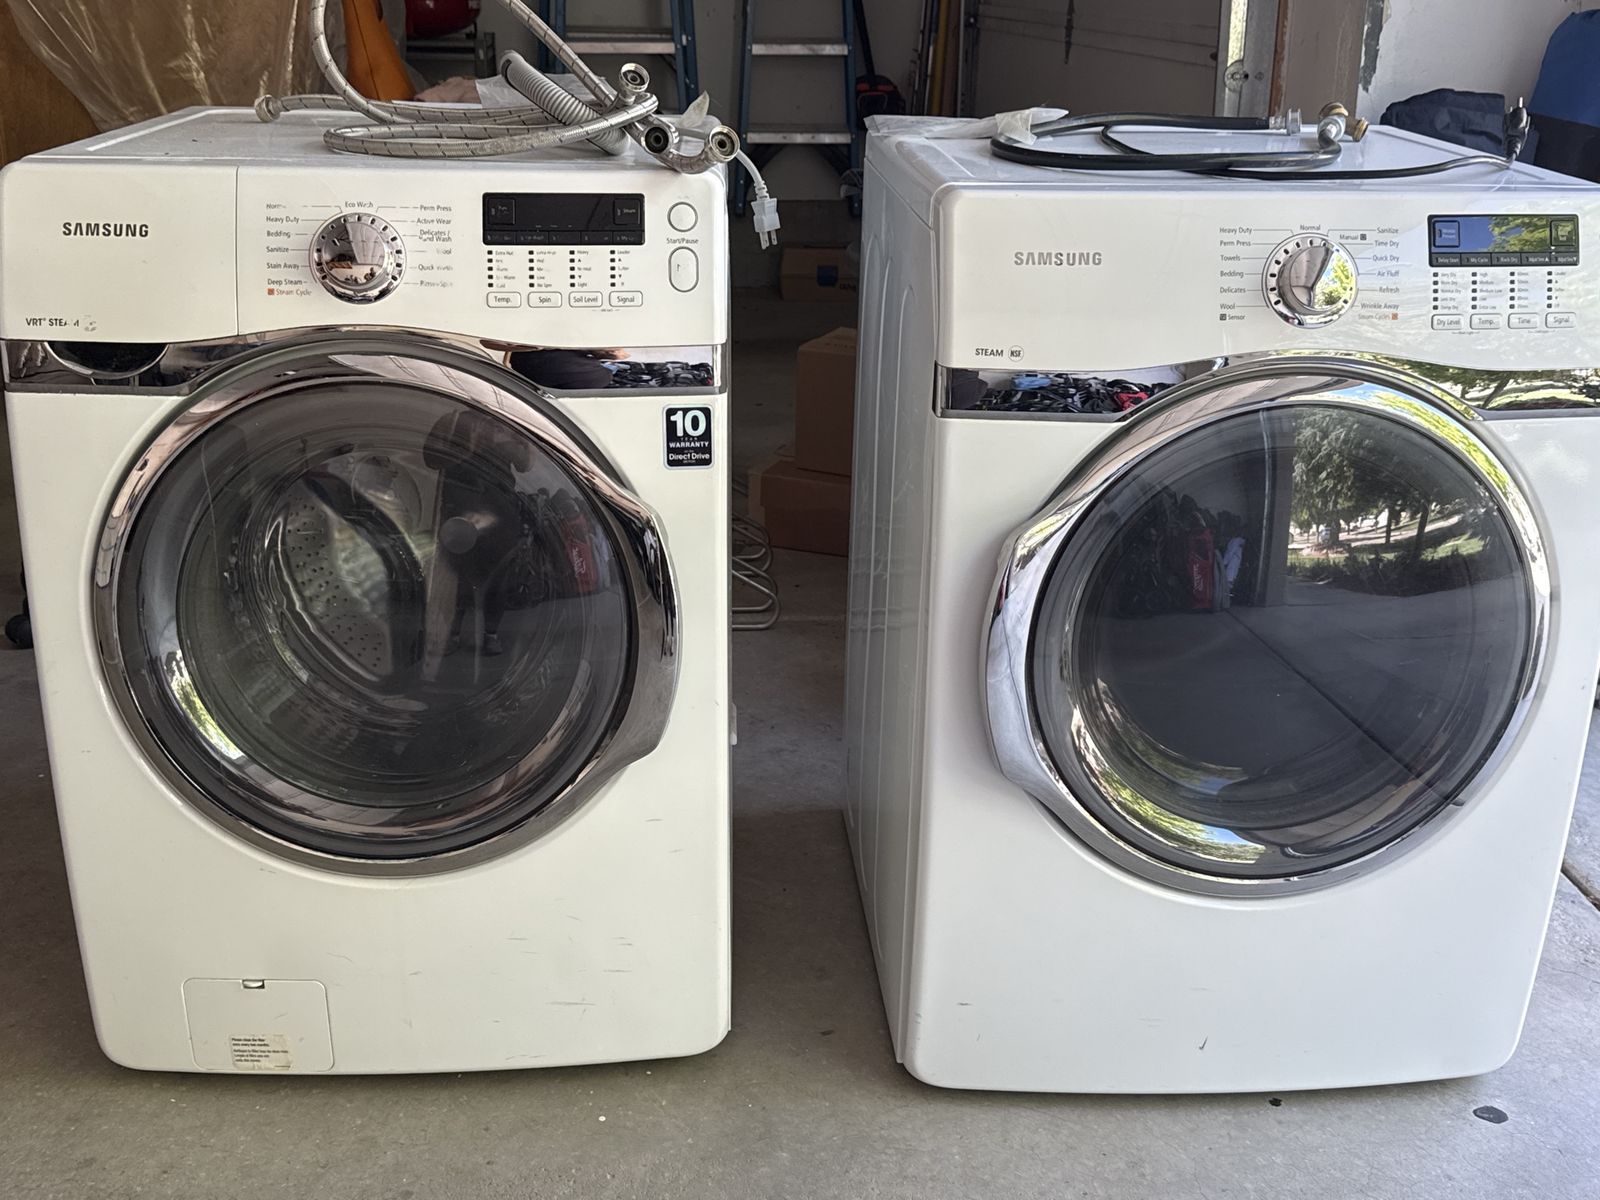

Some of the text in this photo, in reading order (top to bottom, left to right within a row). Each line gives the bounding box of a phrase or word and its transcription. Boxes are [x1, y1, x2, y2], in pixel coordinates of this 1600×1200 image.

[266, 216, 284, 224] Heavy
[62, 222, 149, 238] SAMSUNG
[267, 230, 291, 238] Bedding
[1014, 252, 1102, 266] SAMSUNG
[1389, 254, 1399, 262] Dry
[1220, 270, 1244, 278] Bedding
[539, 296, 551, 304] Spin
[617, 296, 635, 304] Signal
[975, 348, 1004, 357] STEAM
[1010, 350, 1021, 358] NSF
[670, 409, 706, 437] 10
